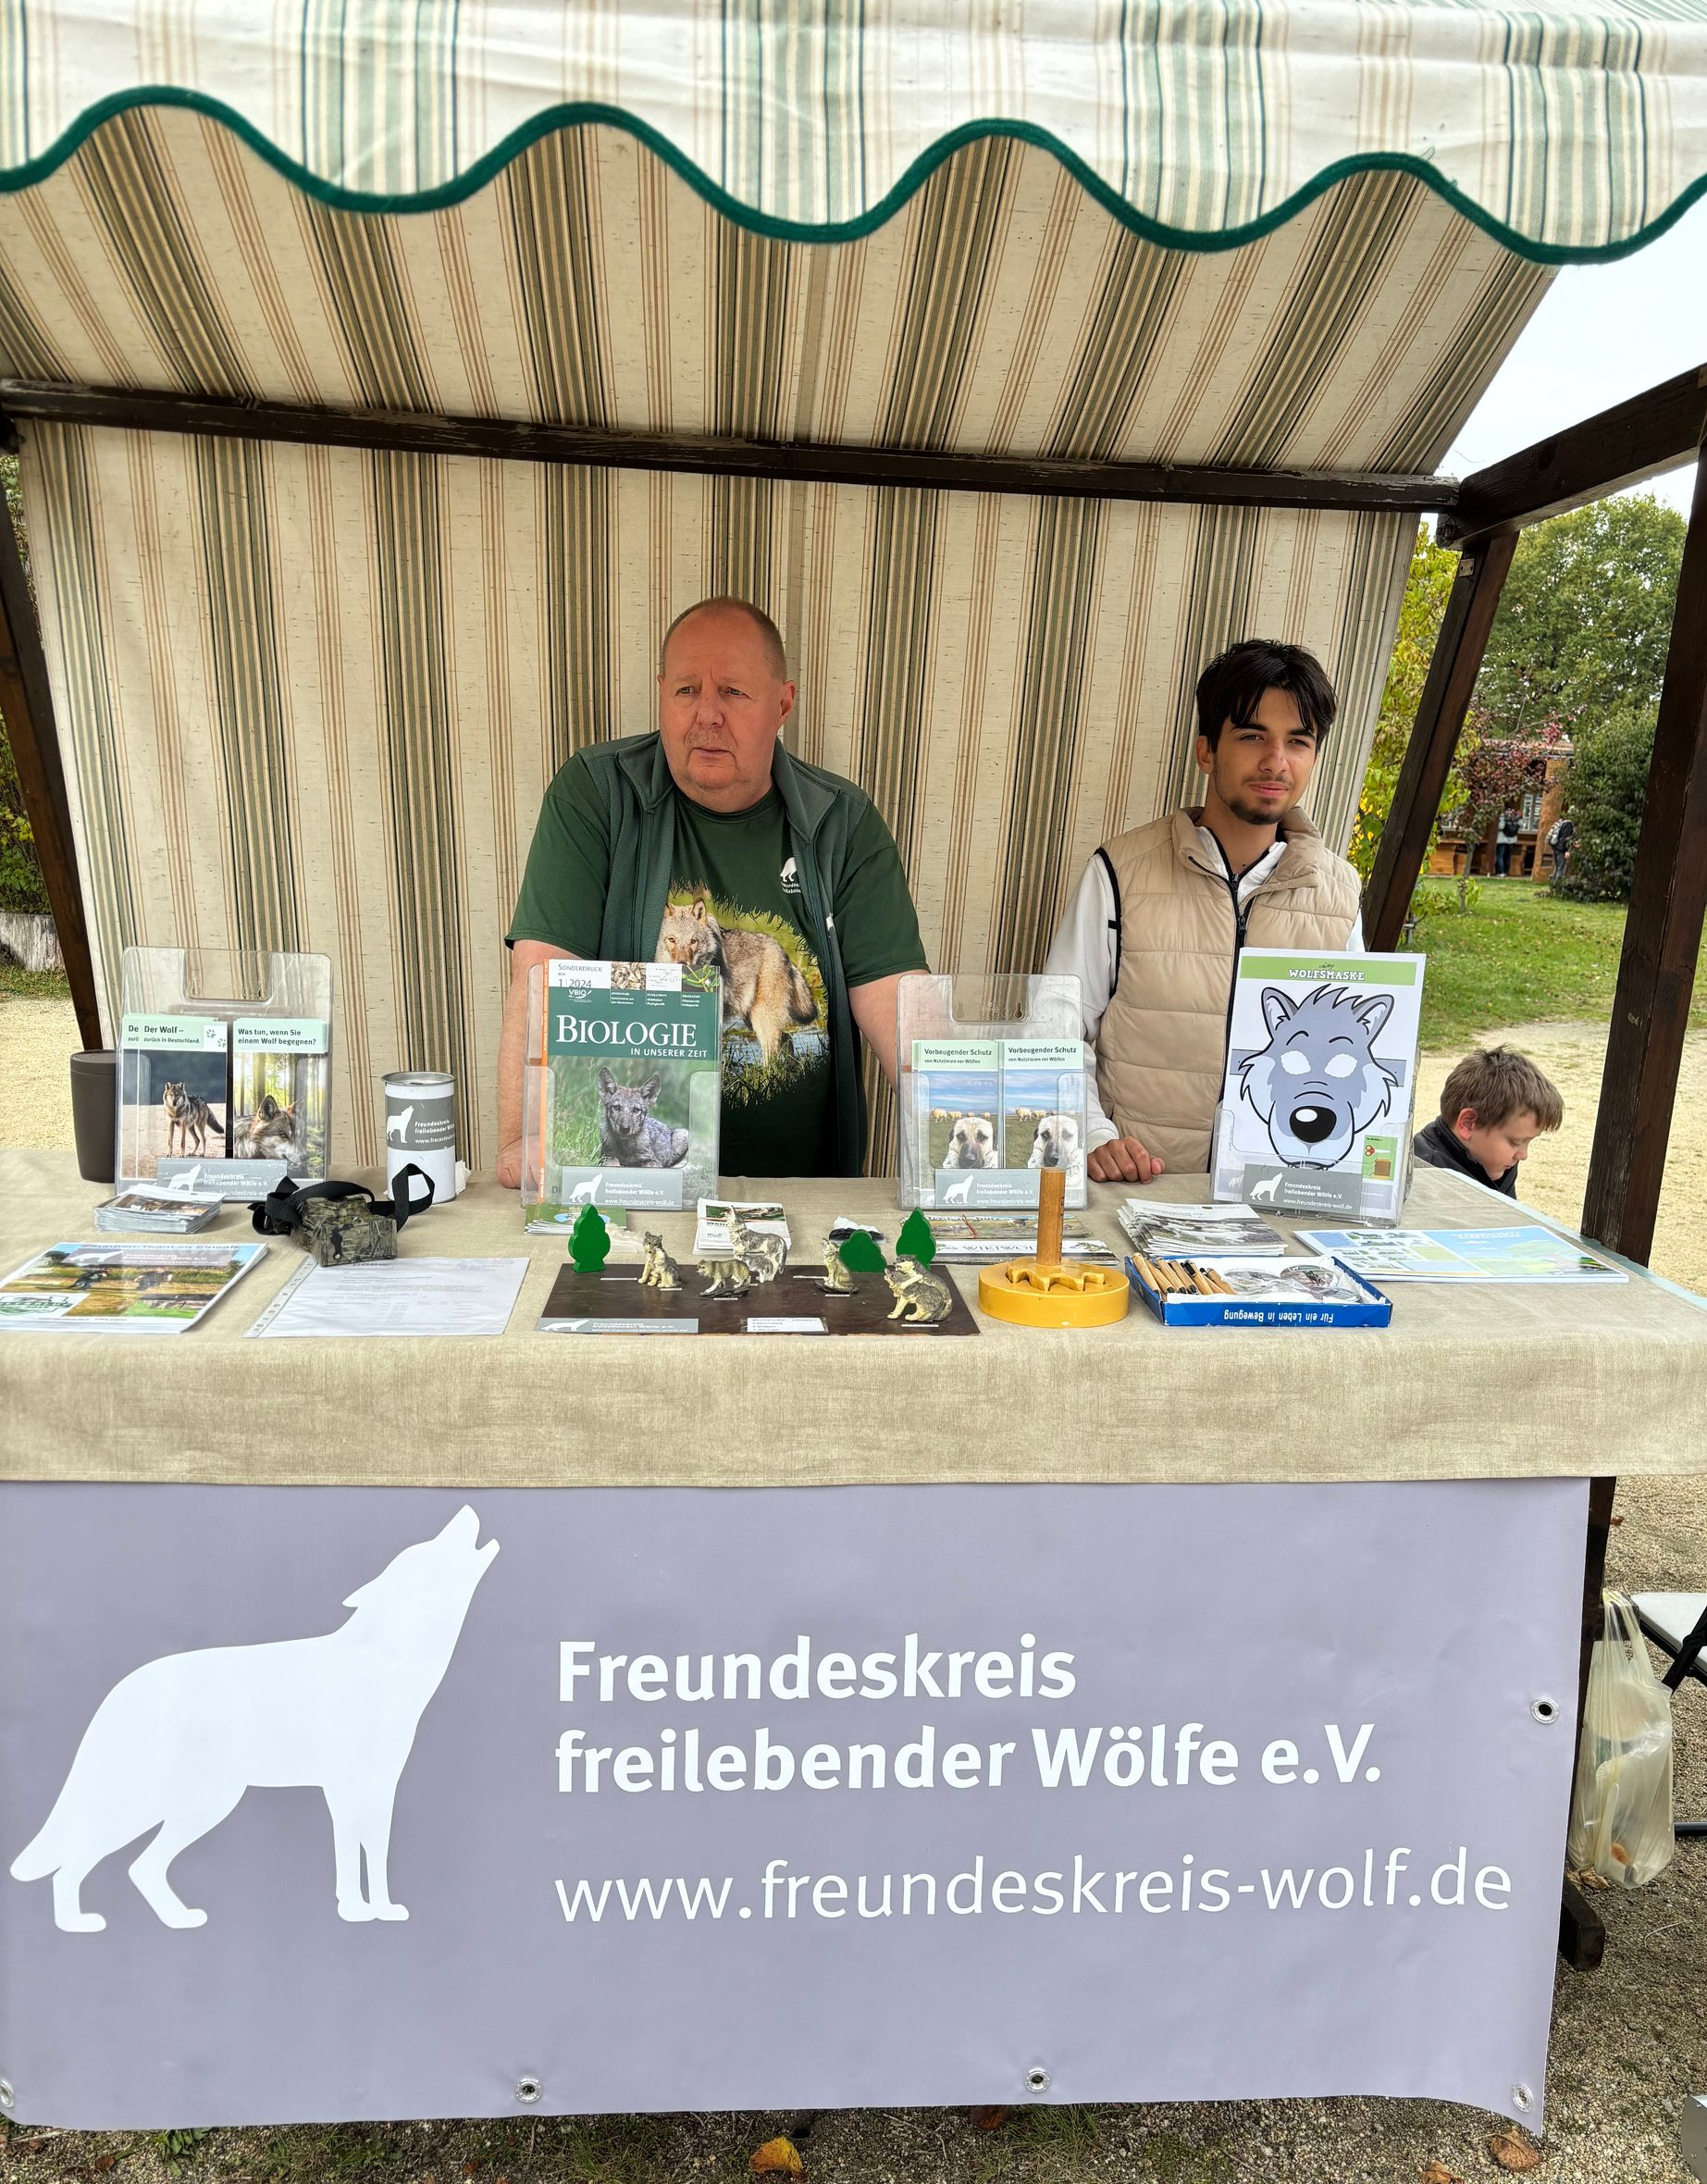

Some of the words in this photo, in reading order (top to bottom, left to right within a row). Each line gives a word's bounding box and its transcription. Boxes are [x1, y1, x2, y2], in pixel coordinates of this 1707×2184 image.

[558, 963, 602, 973] SONDERDRUCK
[1288, 969, 1365, 981] WOLFSMASKE
[569, 979, 592, 988] 2024
[129, 1024, 139, 1033] De
[159, 1025, 178, 1034] Wolf
[254, 1028, 268, 1036] tun,
[556, 1014, 697, 1047] BIOLOGIE
[630, 1048, 641, 1056] IN
[644, 1048, 685, 1057] UNSERER
[687, 1049, 708, 1058] ZEIT
[924, 1049, 969, 1057] Vorbeugender
[1008, 1047, 1053, 1055] Vorbeugender
[1284, 1182, 1321, 1191] Freundeskreis
[1283, 1188, 1317, 1197] freilebender
[605, 1198, 674, 1207] www.freundeskreis-wolf.de
[1283, 1198, 1353, 1210] www.freundeskreis-wolf.de
[1224, 1309, 1264, 1322] Bewegung
[1268, 1312, 1275, 1322] in
[1279, 1312, 1302, 1322] Leben
[1305, 1312, 1317, 1322] ein
[1320, 1312, 1334, 1323] Für
[559, 1632, 1076, 1702] Freundeskreis
[555, 1725, 1017, 1793] freilebender
[1032, 1722, 1239, 1788] Wölfe
[1261, 1723, 1381, 1785] e.V.
[555, 1846, 1512, 1922] www.freundeskreis-wolf.de
